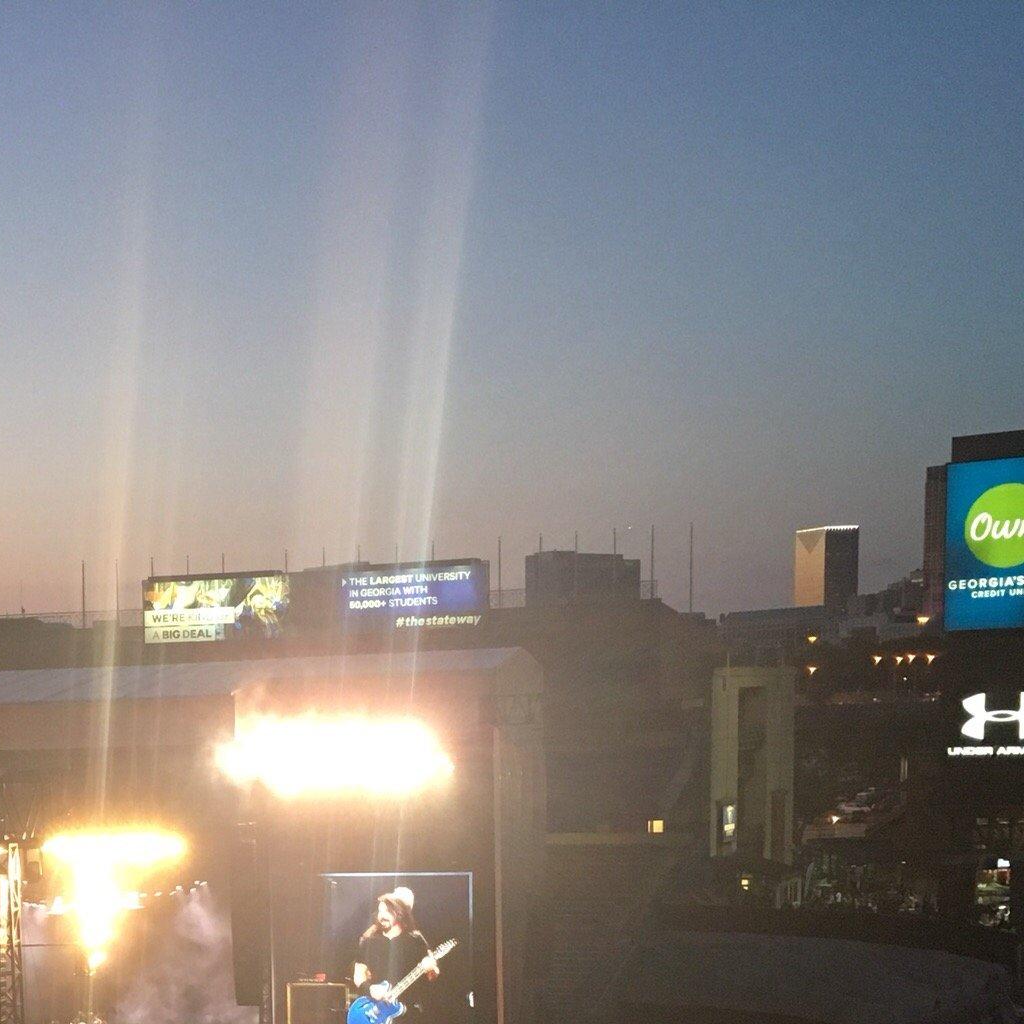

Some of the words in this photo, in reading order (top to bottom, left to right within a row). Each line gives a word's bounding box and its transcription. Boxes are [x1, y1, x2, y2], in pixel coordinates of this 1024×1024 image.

[349, 577, 367, 586] THE
[370, 574, 414, 585] LARGEST
[415, 571, 471, 582] UNIVERSITY
[948, 575, 1024, 590] GEORGIA'S
[349, 589, 358, 598] IN
[360, 587, 401, 597] GEORGIA
[402, 586, 428, 595] WITH
[971, 589, 1005, 598] CREDIT
[349, 599, 386, 610] 50,000+
[389, 597, 438, 607] STUDENTS
[152, 614, 185, 623] WE'RE
[396, 615, 481, 627] #thestateway
[152, 631, 160, 640] A
[162, 630, 180, 639] BIG
[183, 629, 212, 638] DEAL
[947, 746, 994, 756] UNDER
